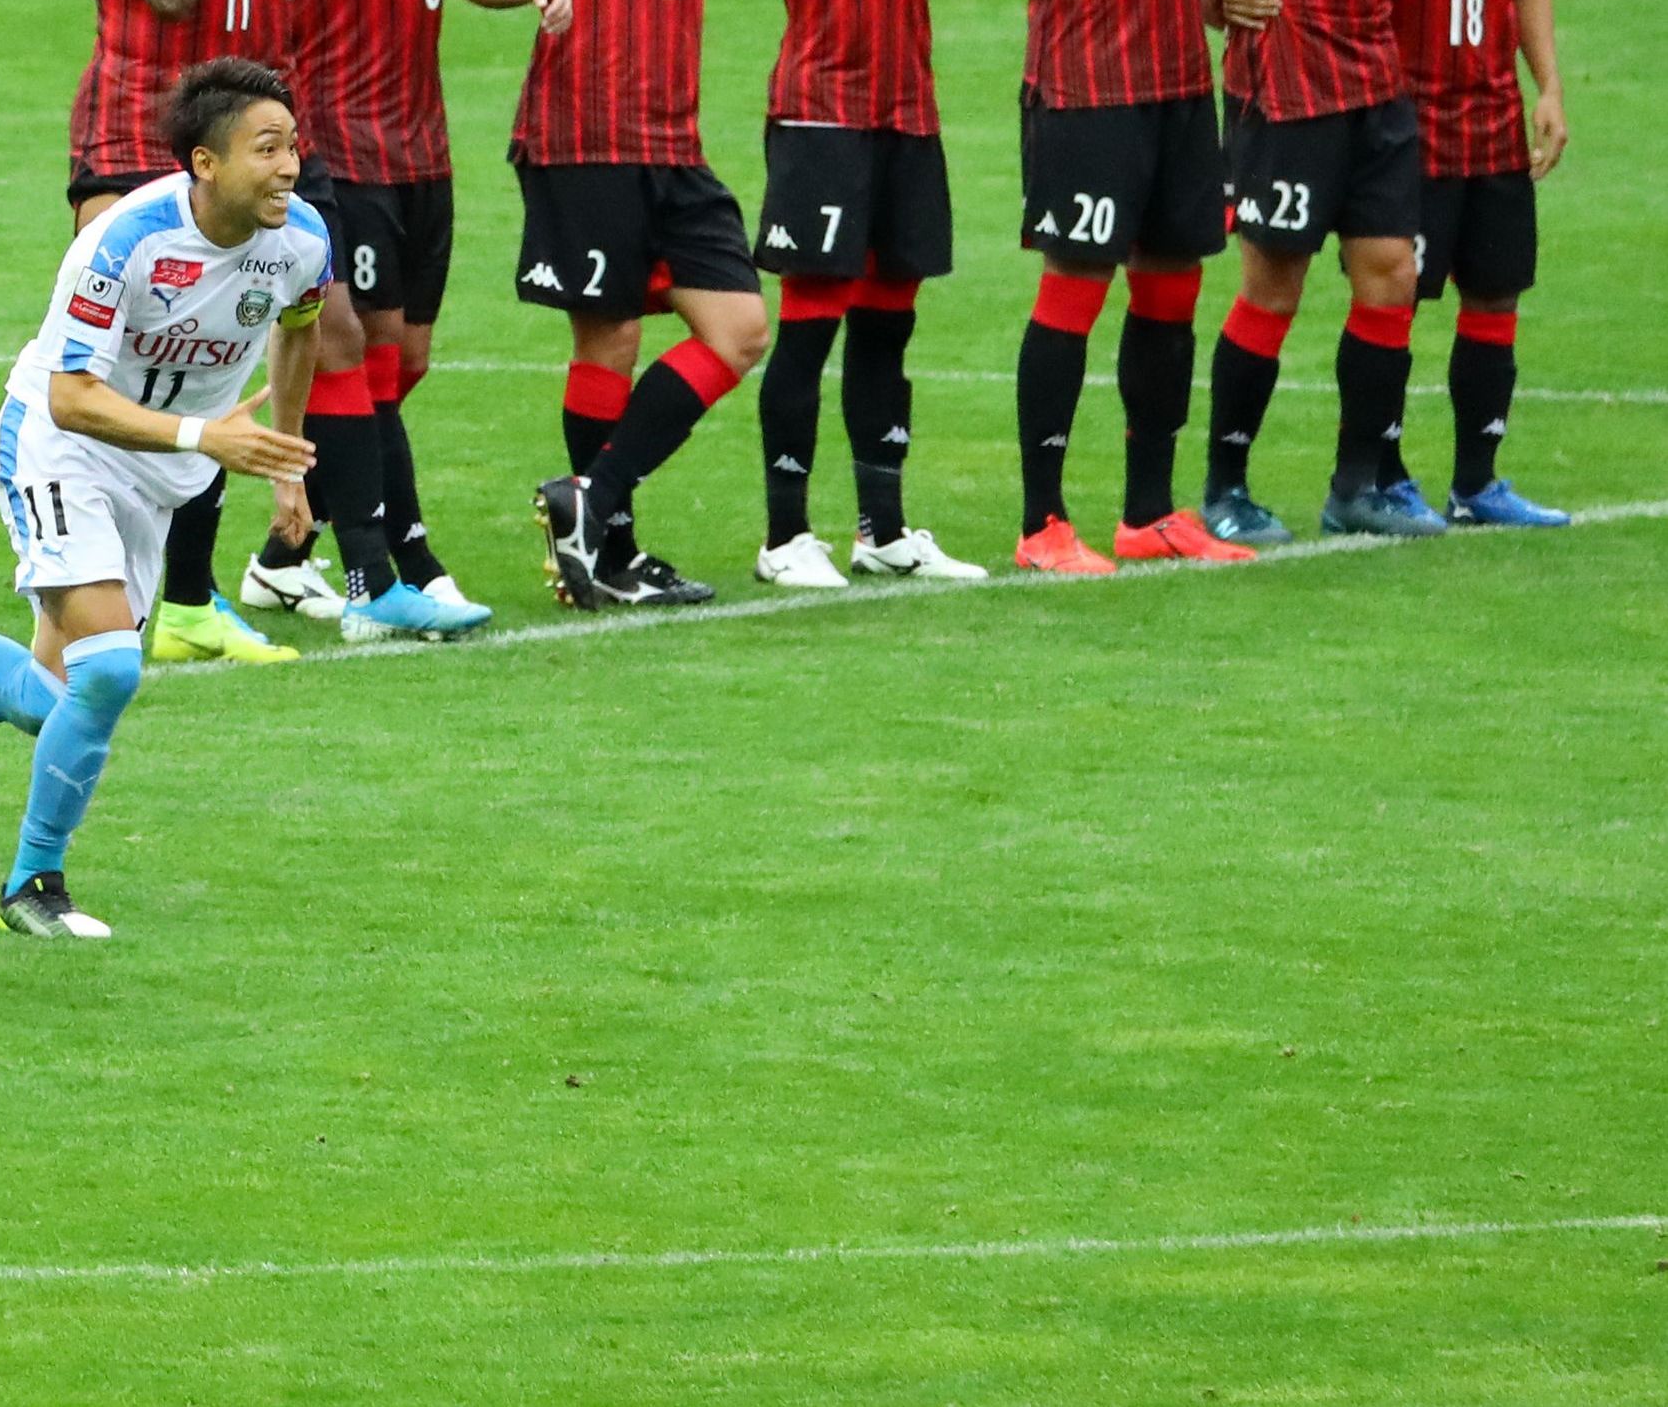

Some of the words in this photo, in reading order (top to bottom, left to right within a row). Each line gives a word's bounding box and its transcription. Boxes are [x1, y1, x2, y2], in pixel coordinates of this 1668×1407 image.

[820, 205, 843, 253] 7
[1069, 193, 1116, 245] 20
[1269, 180, 1310, 231] 23
[353, 244, 377, 291] 8
[582, 249, 607, 297] 2
[124, 326, 252, 367] UJITSU
[138, 368, 187, 410] 11
[24, 479, 69, 540] 11
